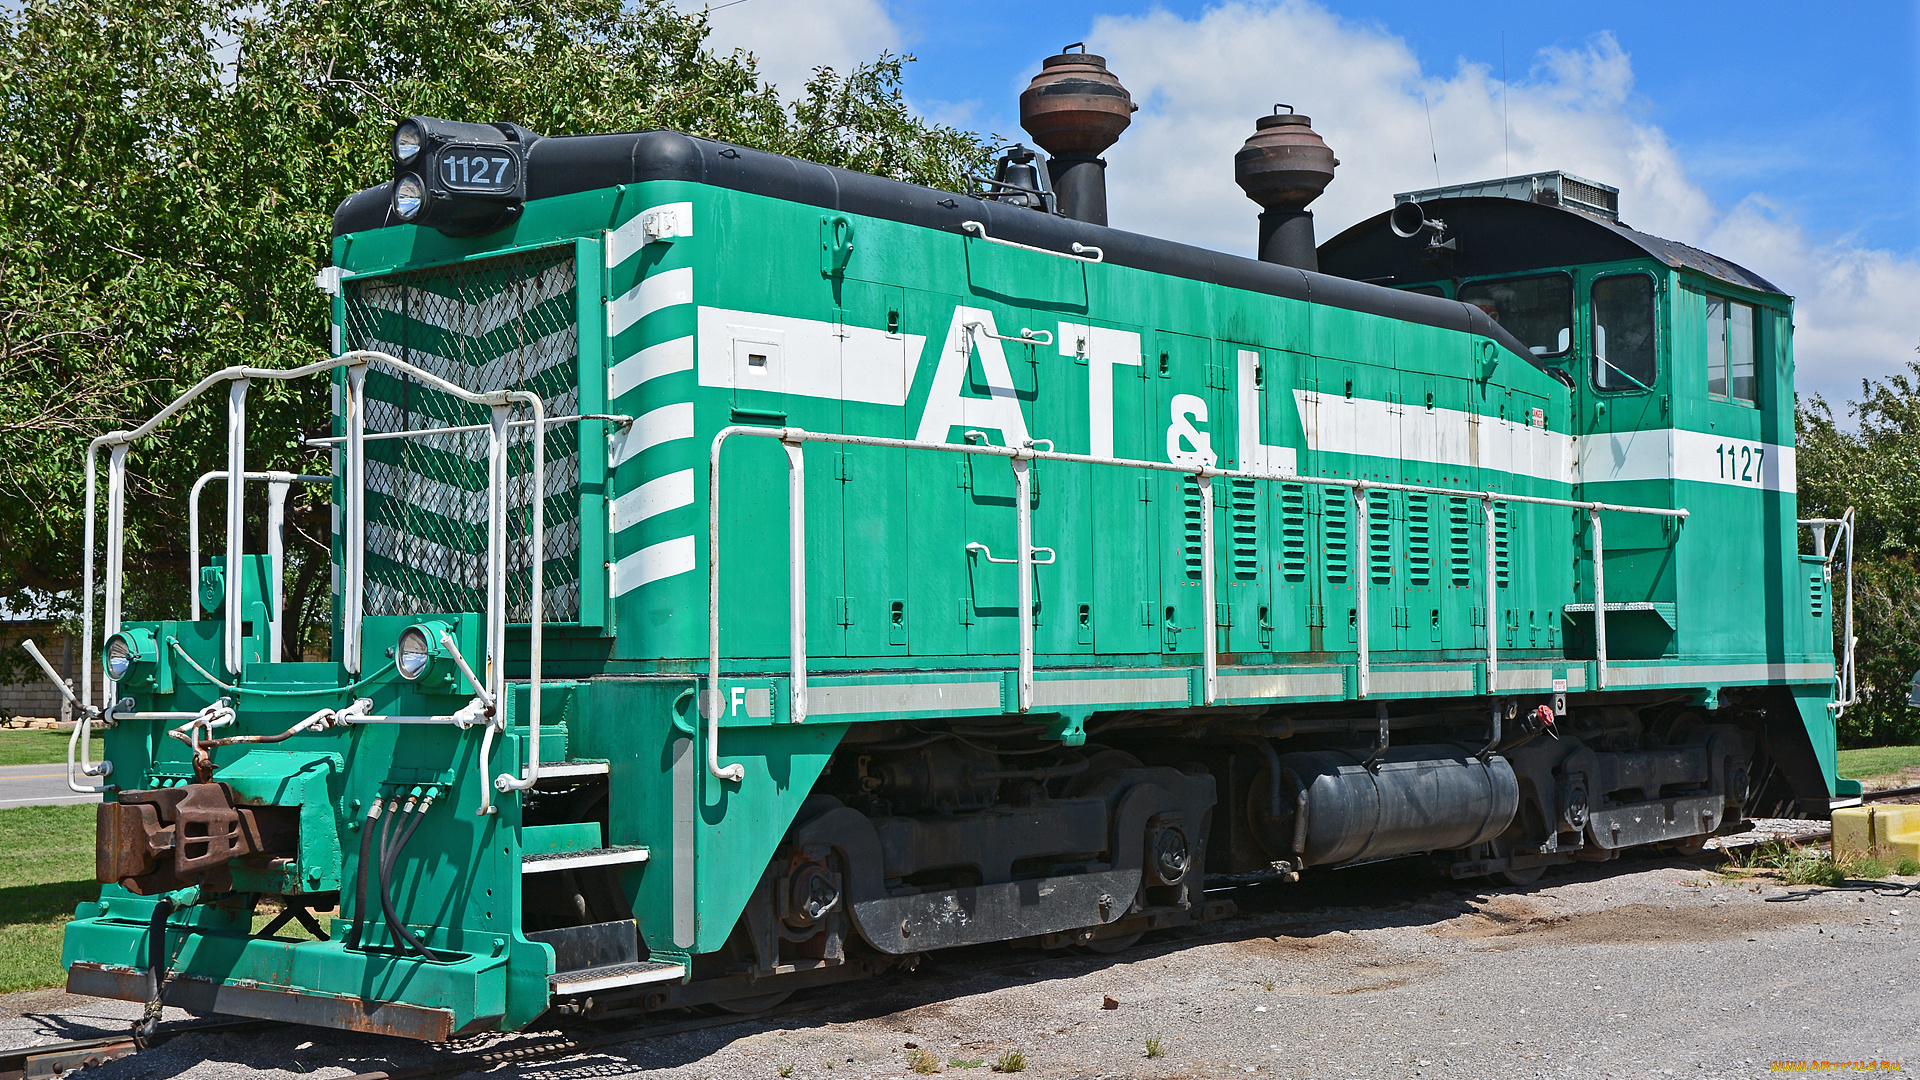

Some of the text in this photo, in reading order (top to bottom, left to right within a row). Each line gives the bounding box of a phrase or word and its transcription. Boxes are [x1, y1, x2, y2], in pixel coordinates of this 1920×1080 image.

[443, 155, 510, 184] 1127
[1716, 443, 1764, 483] 1127
[731, 687, 745, 717] F
